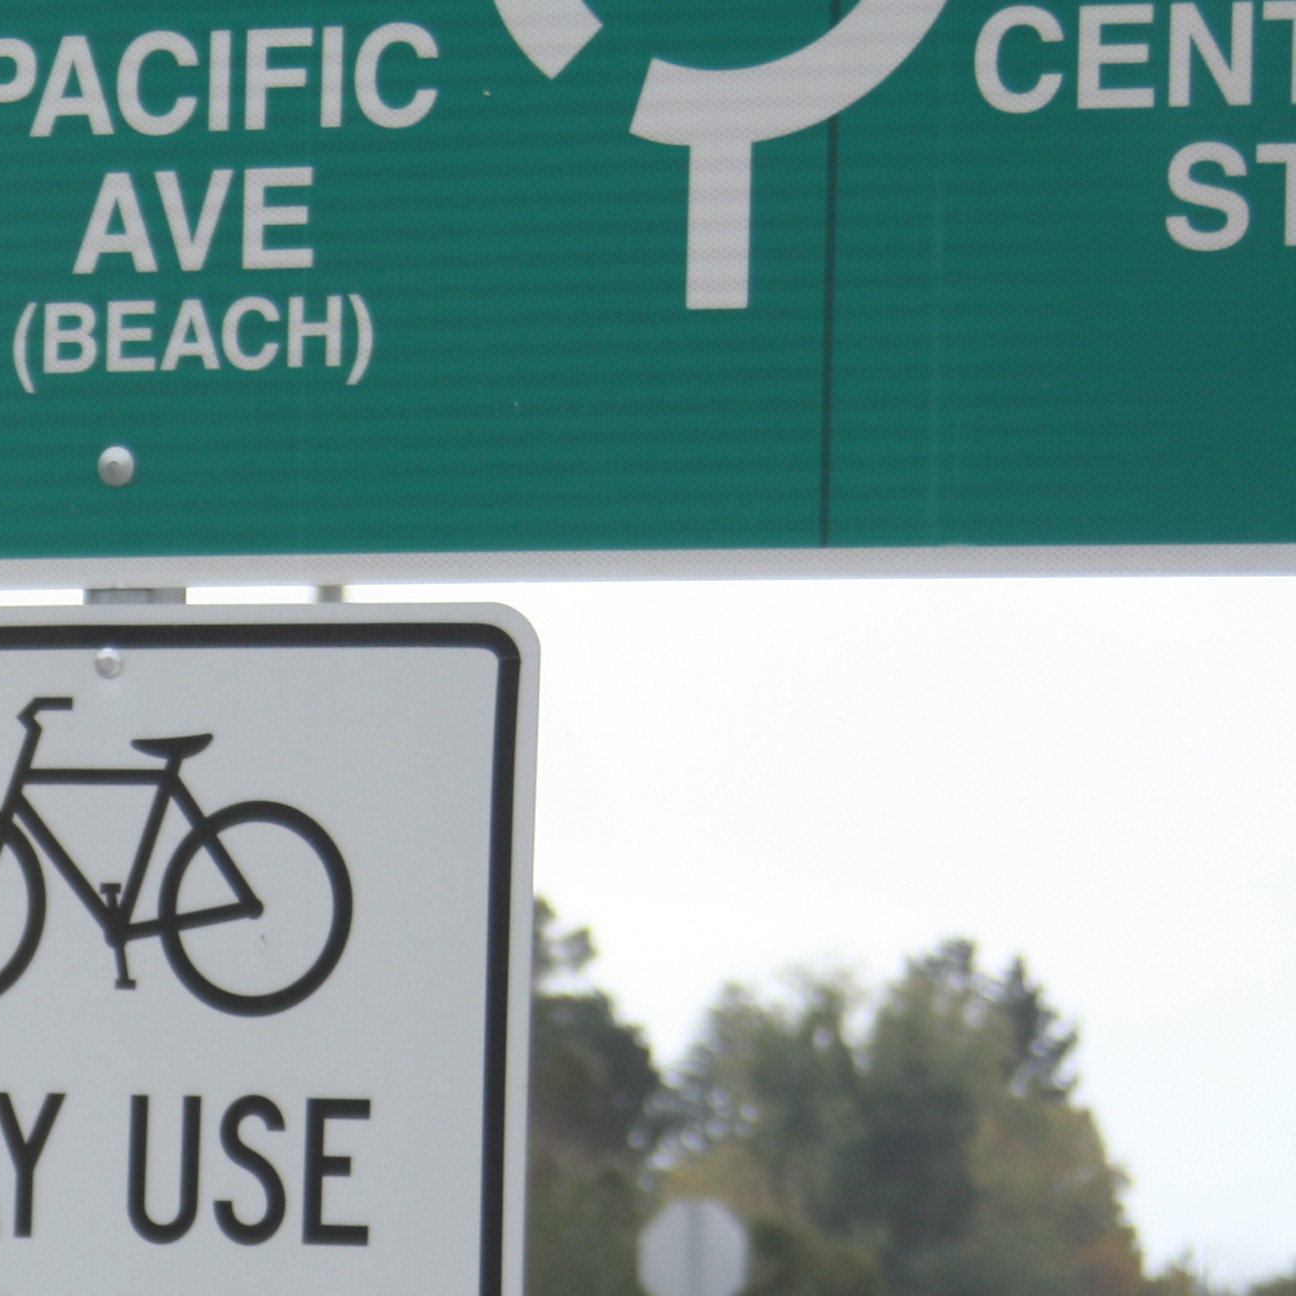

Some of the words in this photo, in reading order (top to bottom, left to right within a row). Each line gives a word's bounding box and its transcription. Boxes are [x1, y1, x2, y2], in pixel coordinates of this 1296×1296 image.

[73, 166, 314, 275] AVE
[1165, 141, 1296, 252] ST
[13, 294, 374, 394] (BEACH)
[127, 1094, 371, 1246] USE
